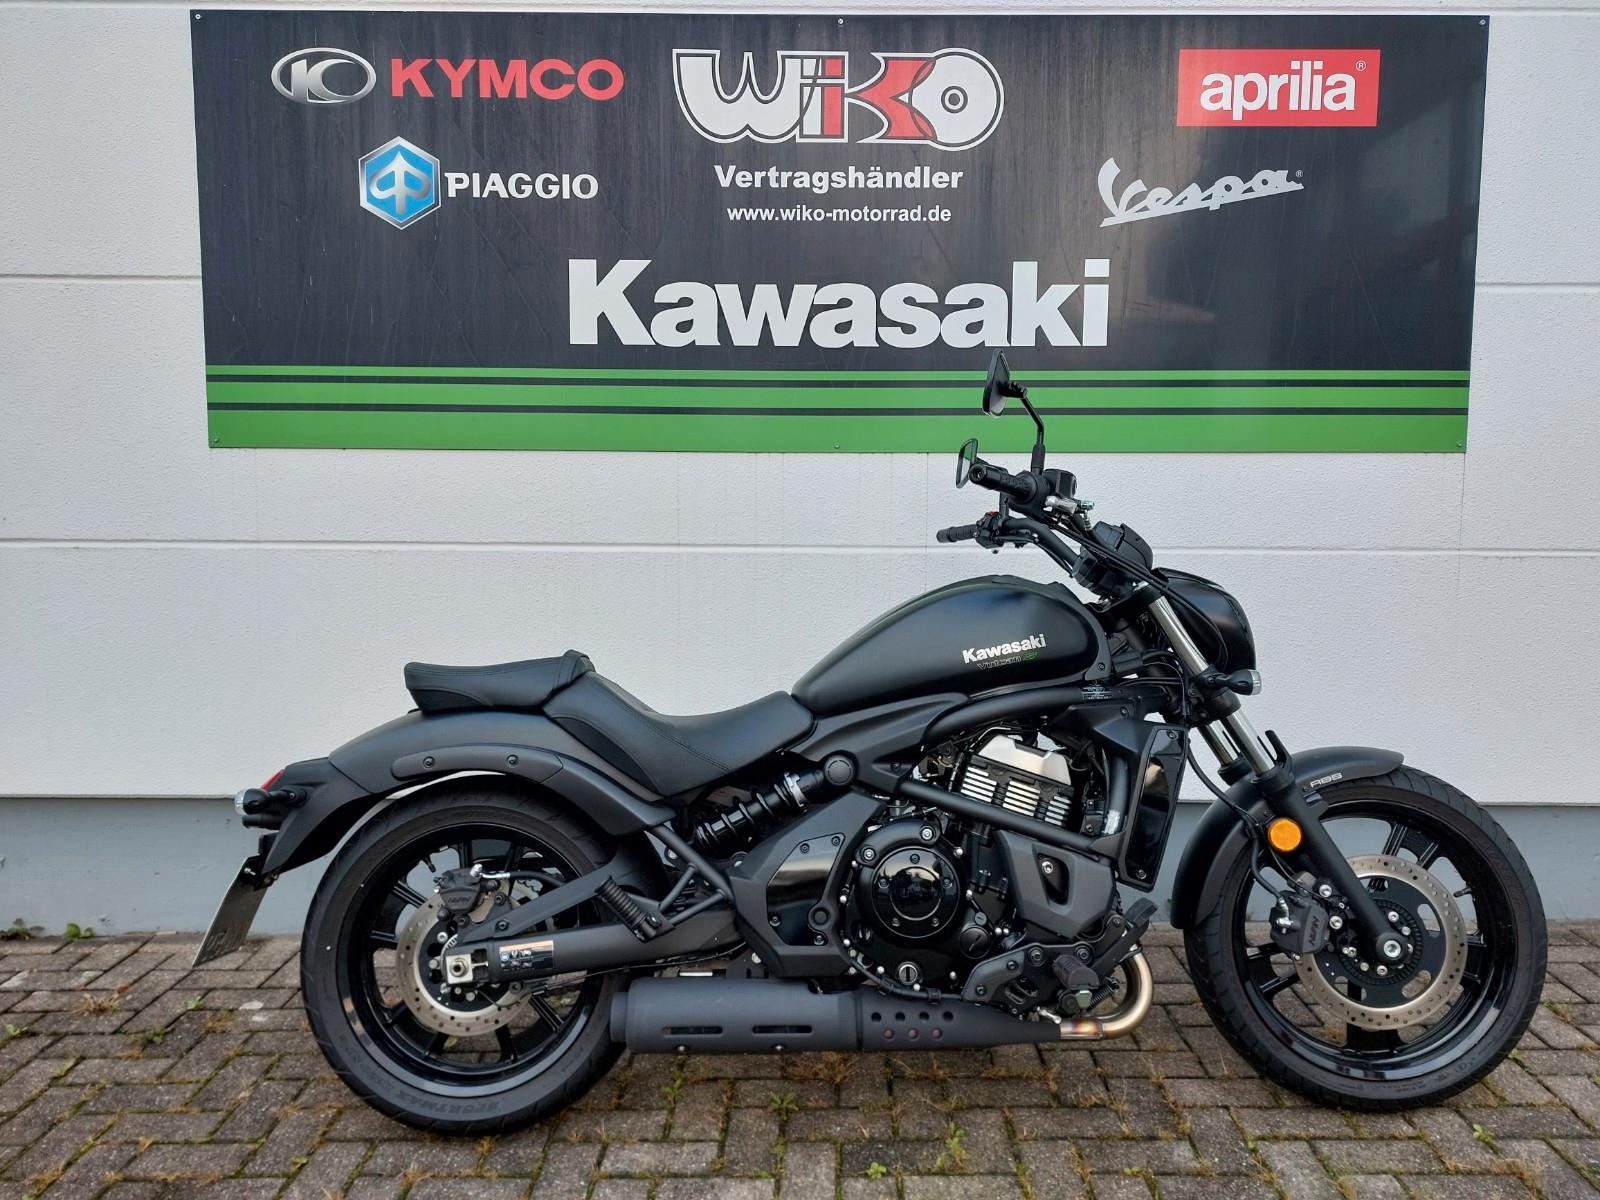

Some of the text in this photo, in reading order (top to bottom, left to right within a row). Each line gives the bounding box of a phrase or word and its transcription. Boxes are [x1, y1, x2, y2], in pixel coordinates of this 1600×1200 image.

[391, 58, 625, 101] KYMCO
[1200, 60, 1356, 121] aprilia
[444, 172, 599, 200] PIAGGIO
[713, 165, 963, 194] Vertragshändler
[1097, 157, 1304, 228] Vespa
[727, 205, 952, 222] www.wiko-motorrad.de
[568, 258, 1110, 349] Kawasaki
[962, 633, 1046, 664] Kawasaki
